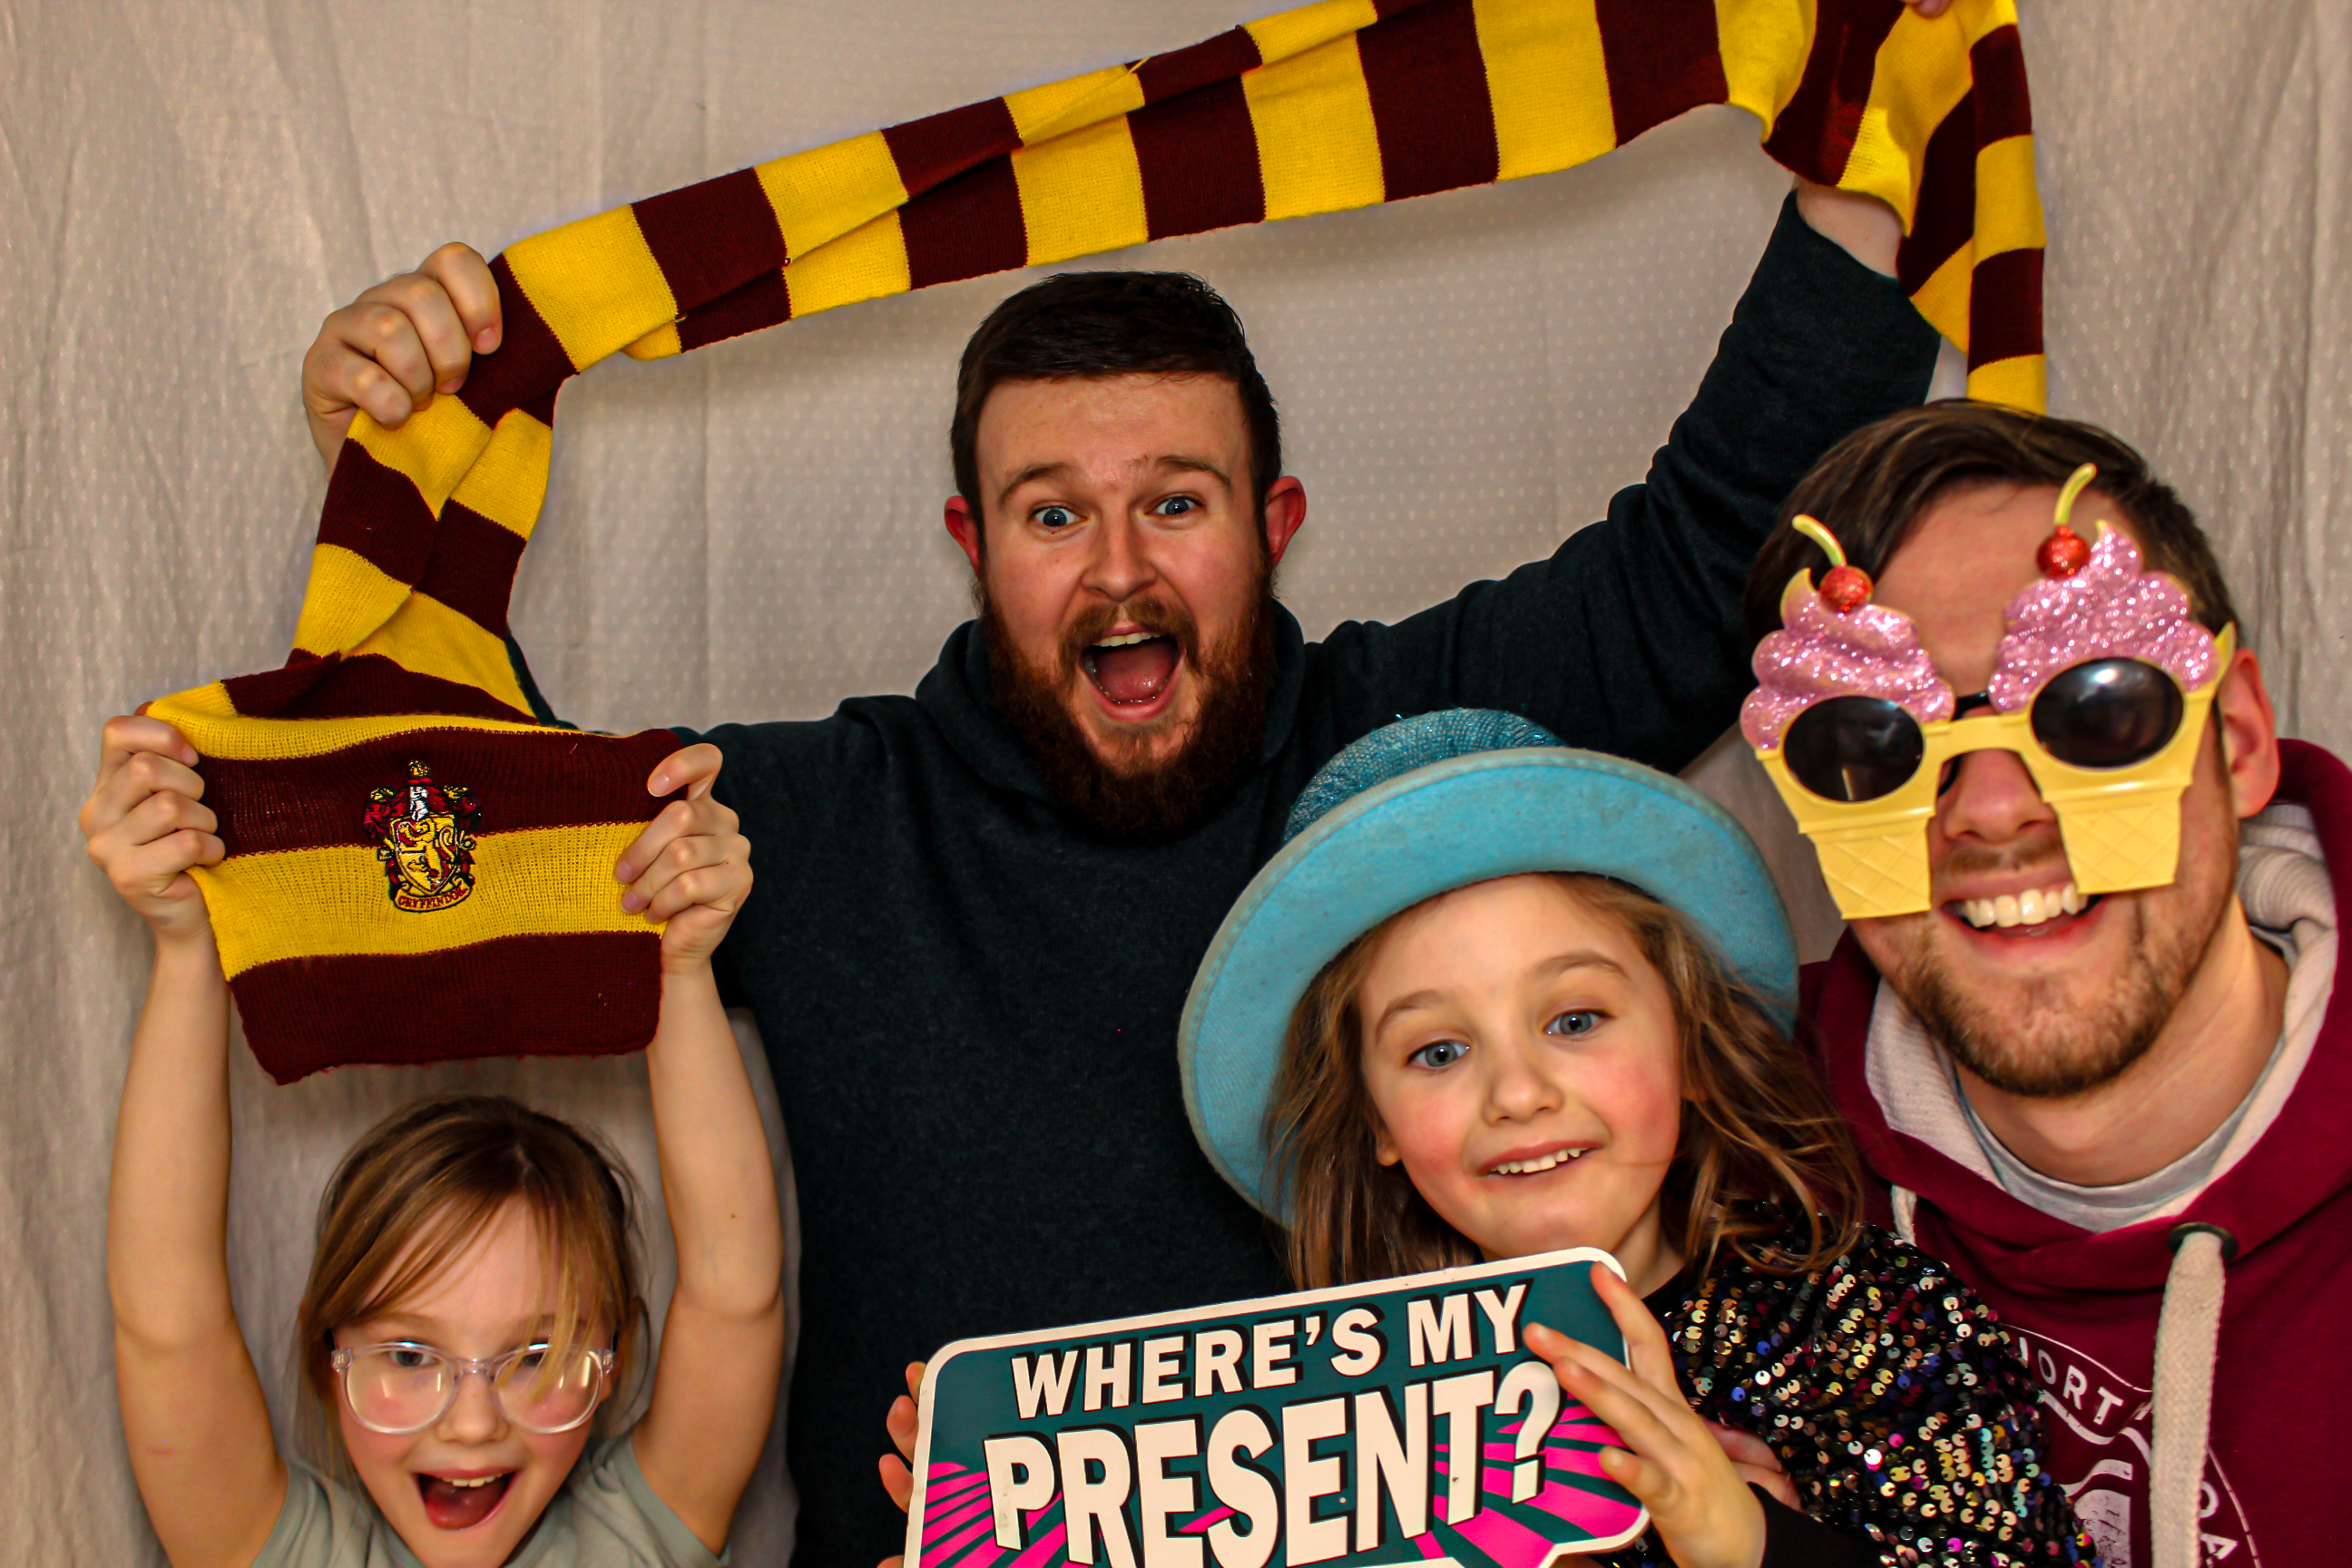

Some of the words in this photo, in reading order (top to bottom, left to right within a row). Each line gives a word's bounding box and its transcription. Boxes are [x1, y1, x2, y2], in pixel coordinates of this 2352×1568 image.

[397, 886, 470, 909] GRYFFINDOR
[1011, 1306, 1385, 1420] WHERE'S
[1406, 1282, 1527, 1367] MY
[983, 1359, 1563, 1568] PRESENT?
